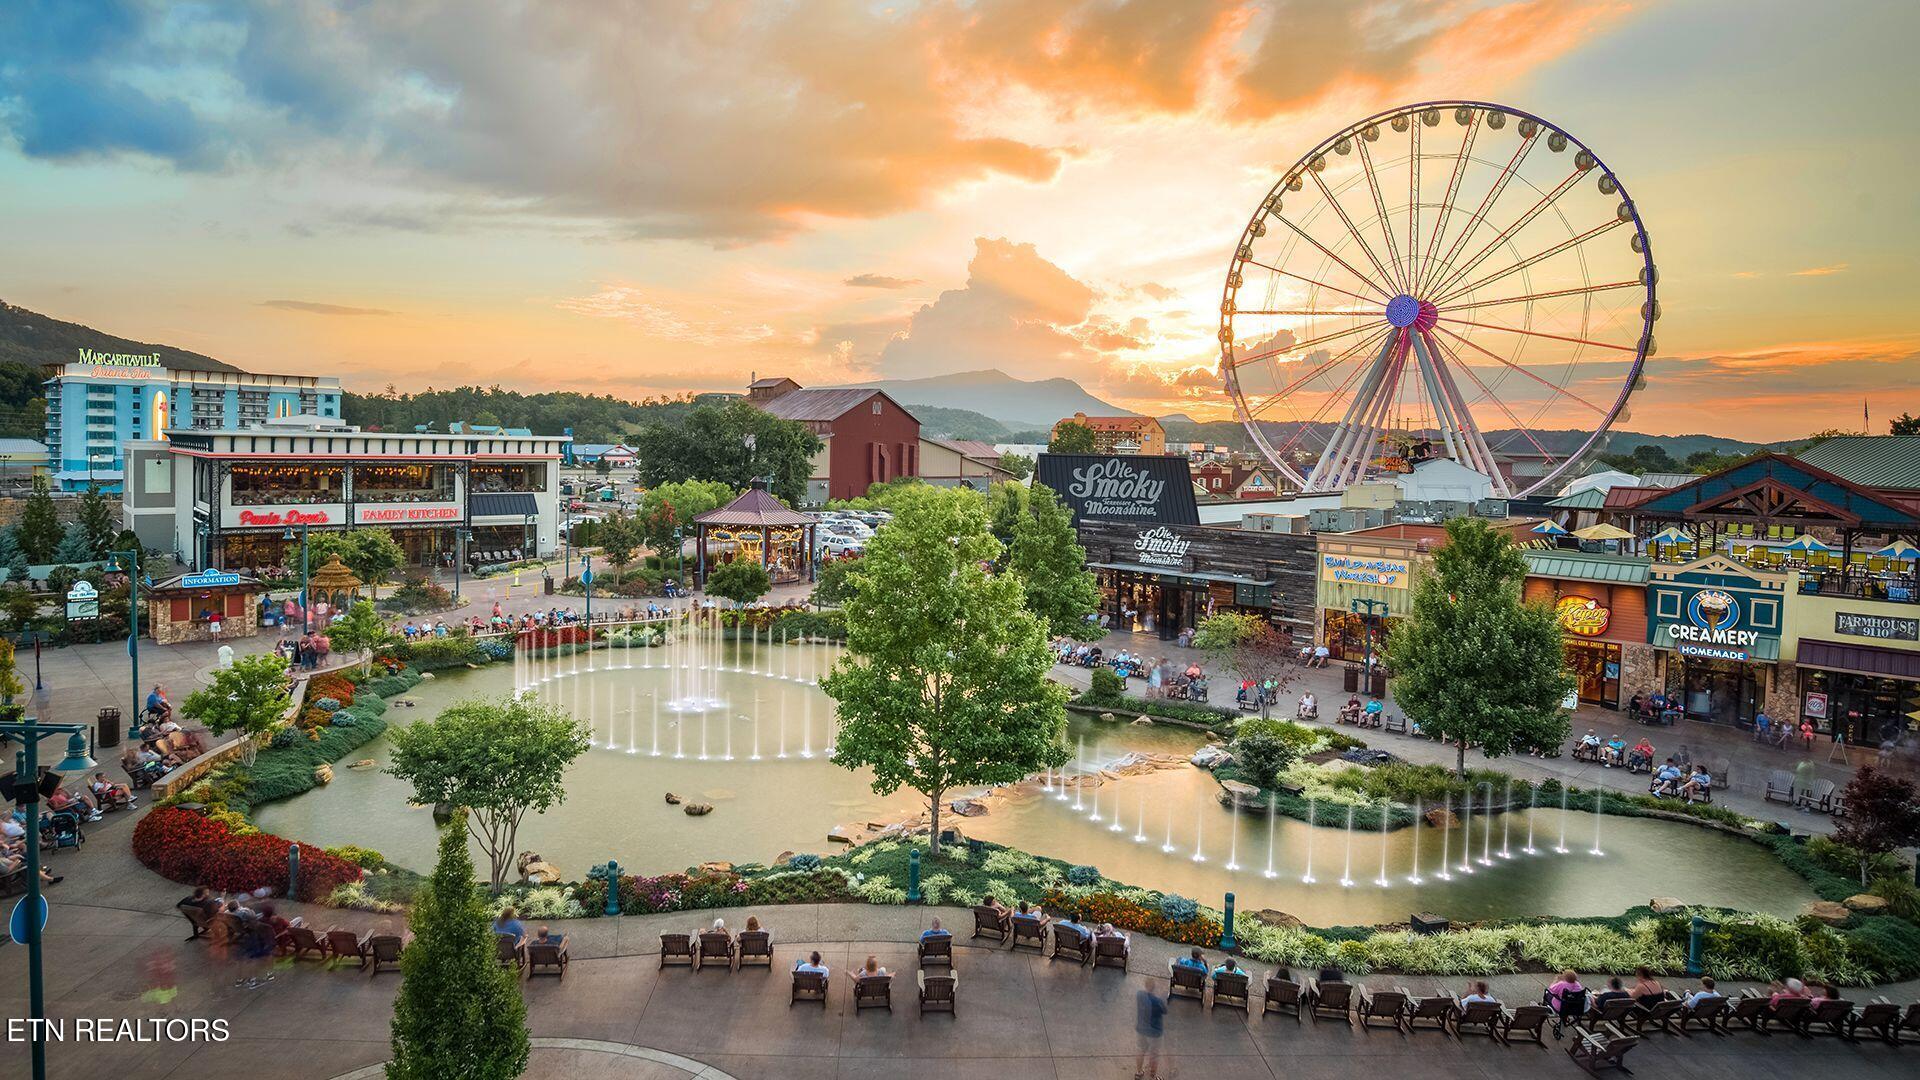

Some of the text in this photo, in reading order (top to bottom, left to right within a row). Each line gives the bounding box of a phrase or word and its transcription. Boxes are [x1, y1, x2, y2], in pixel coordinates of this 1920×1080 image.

[91, 365, 128, 378] Island
[1105, 458, 1138, 480] Ole
[1069, 463, 1165, 505] Smoky
[1084, 500, 1157, 516] Moonshine
[1102, 498, 1132, 506] Tennessee
[239, 509, 330, 525] Paula Deen's
[362, 508, 458, 520] FAMILY KITCHEN
[1155, 526, 1174, 540] Ole
[1134, 529, 1191, 558] Smoky
[1139, 551, 1184, 566] Moonshine
[185, 576, 237, 585] INFORMATION
[1334, 569, 1397, 585] WORKSHOP
[1696, 591, 1733, 605] ISLAND
[1838, 615, 1916, 636] FARMHOUSE
[1863, 626, 1889, 638] 9110
[1668, 623, 1759, 646] CREAMERY
[1681, 645, 1744, 660] HOMEMADE
